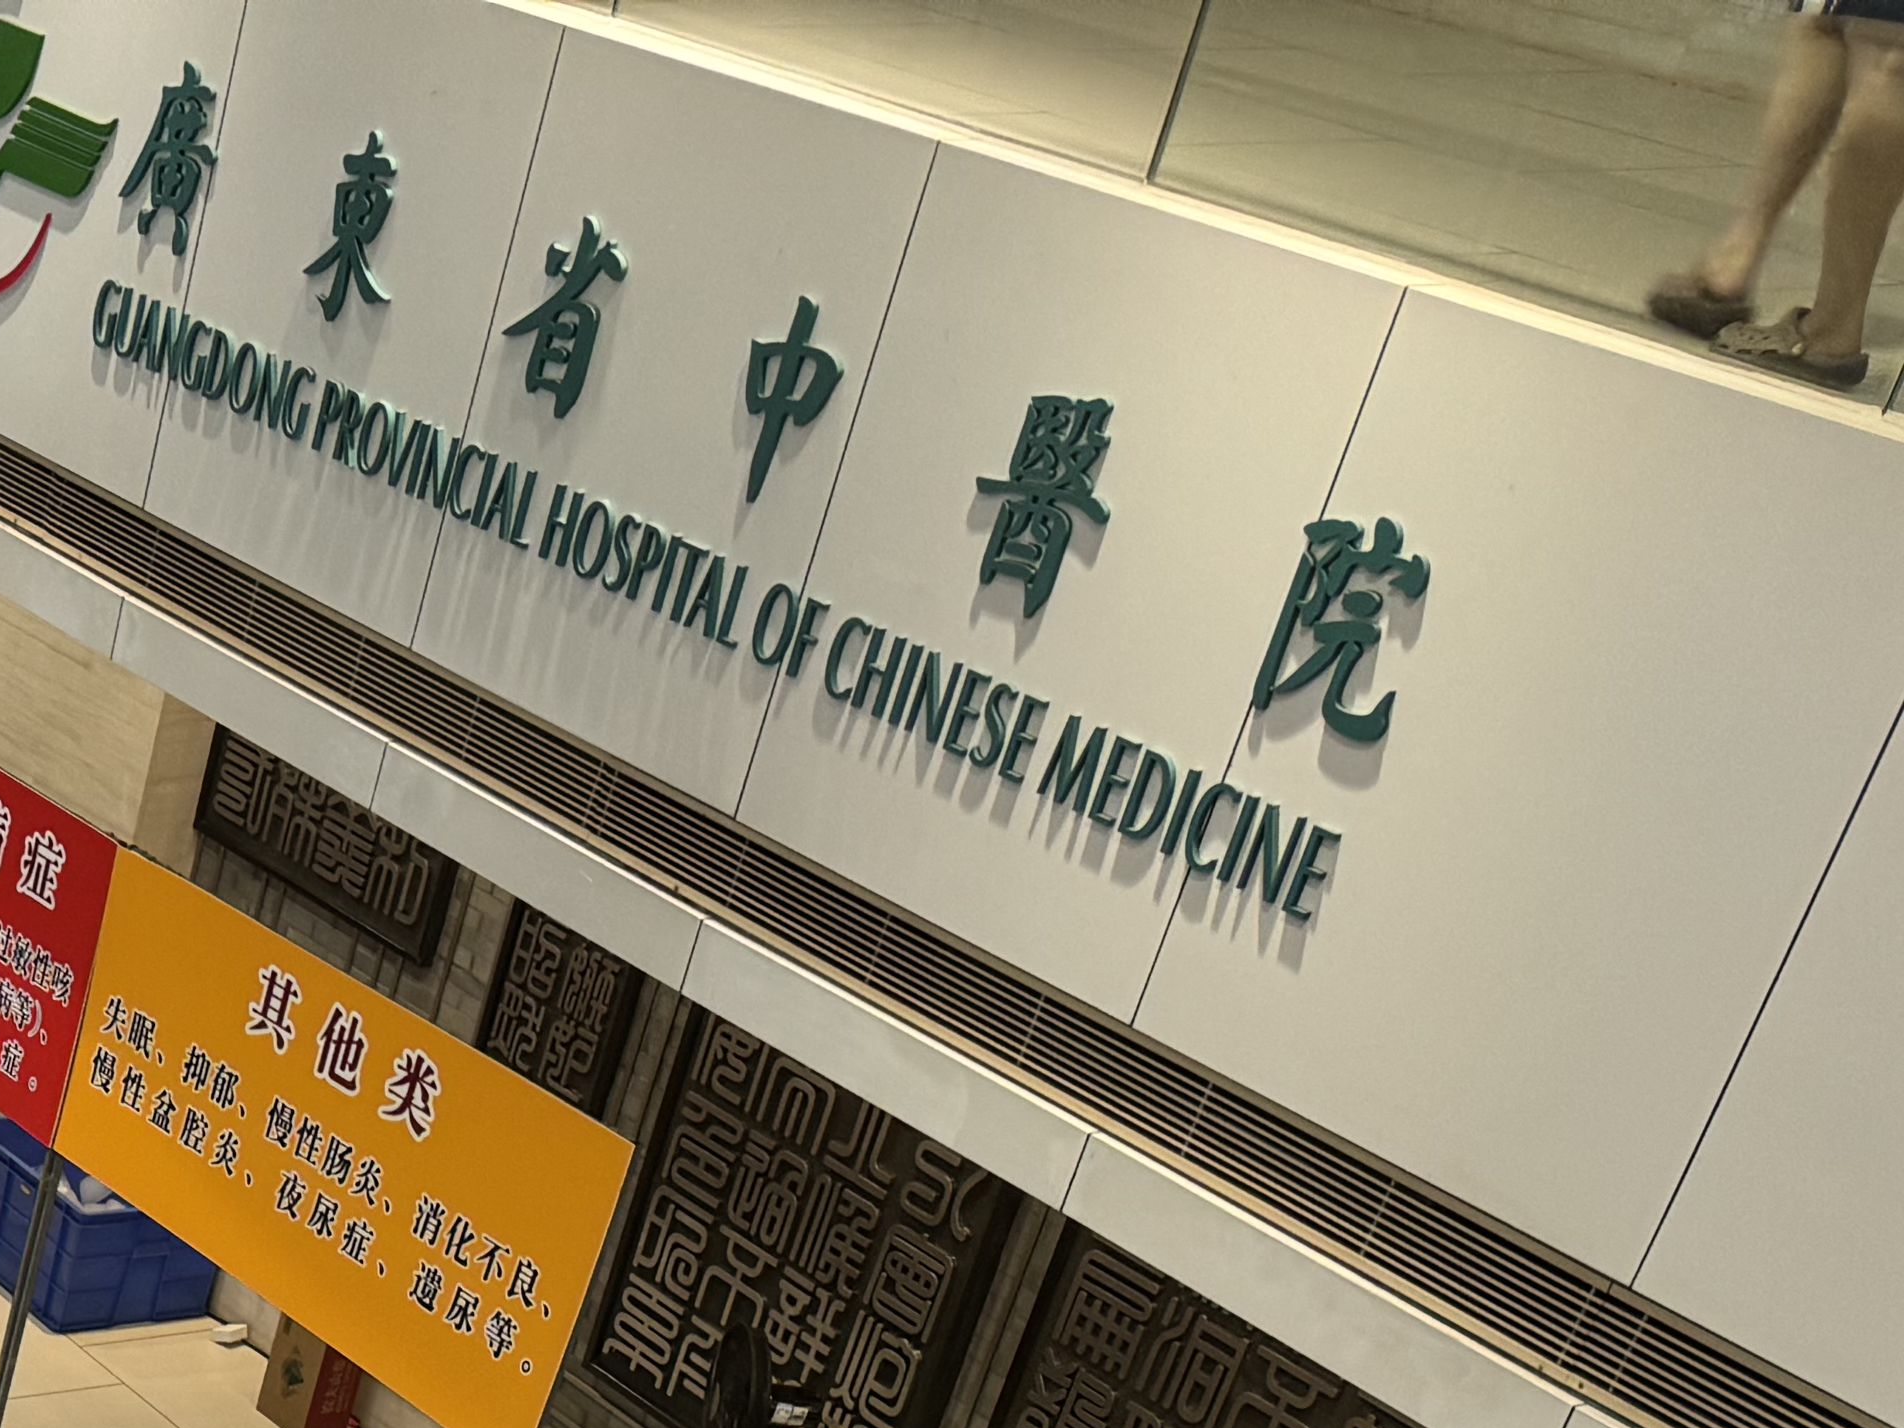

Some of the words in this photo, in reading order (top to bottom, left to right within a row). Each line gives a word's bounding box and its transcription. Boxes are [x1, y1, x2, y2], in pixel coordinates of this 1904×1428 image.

[91, 276, 316, 447] GUANGDONG
[314, 380, 530, 549] PROVINCIAL
[540, 485, 745, 648] HOSPITAL
[754, 583, 828, 670] OF
[826, 616, 1049, 786] CHINESE
[1041, 711, 1344, 924] MEDICINE
[89, 1045, 535, 1376] 慢性盆腔炎、夜尿症、遗尿等。
[101, 995, 552, 1321] 失眠、抑郁、慢性肠炎、消化不良、
[246, 963, 442, 1142] 其他类
